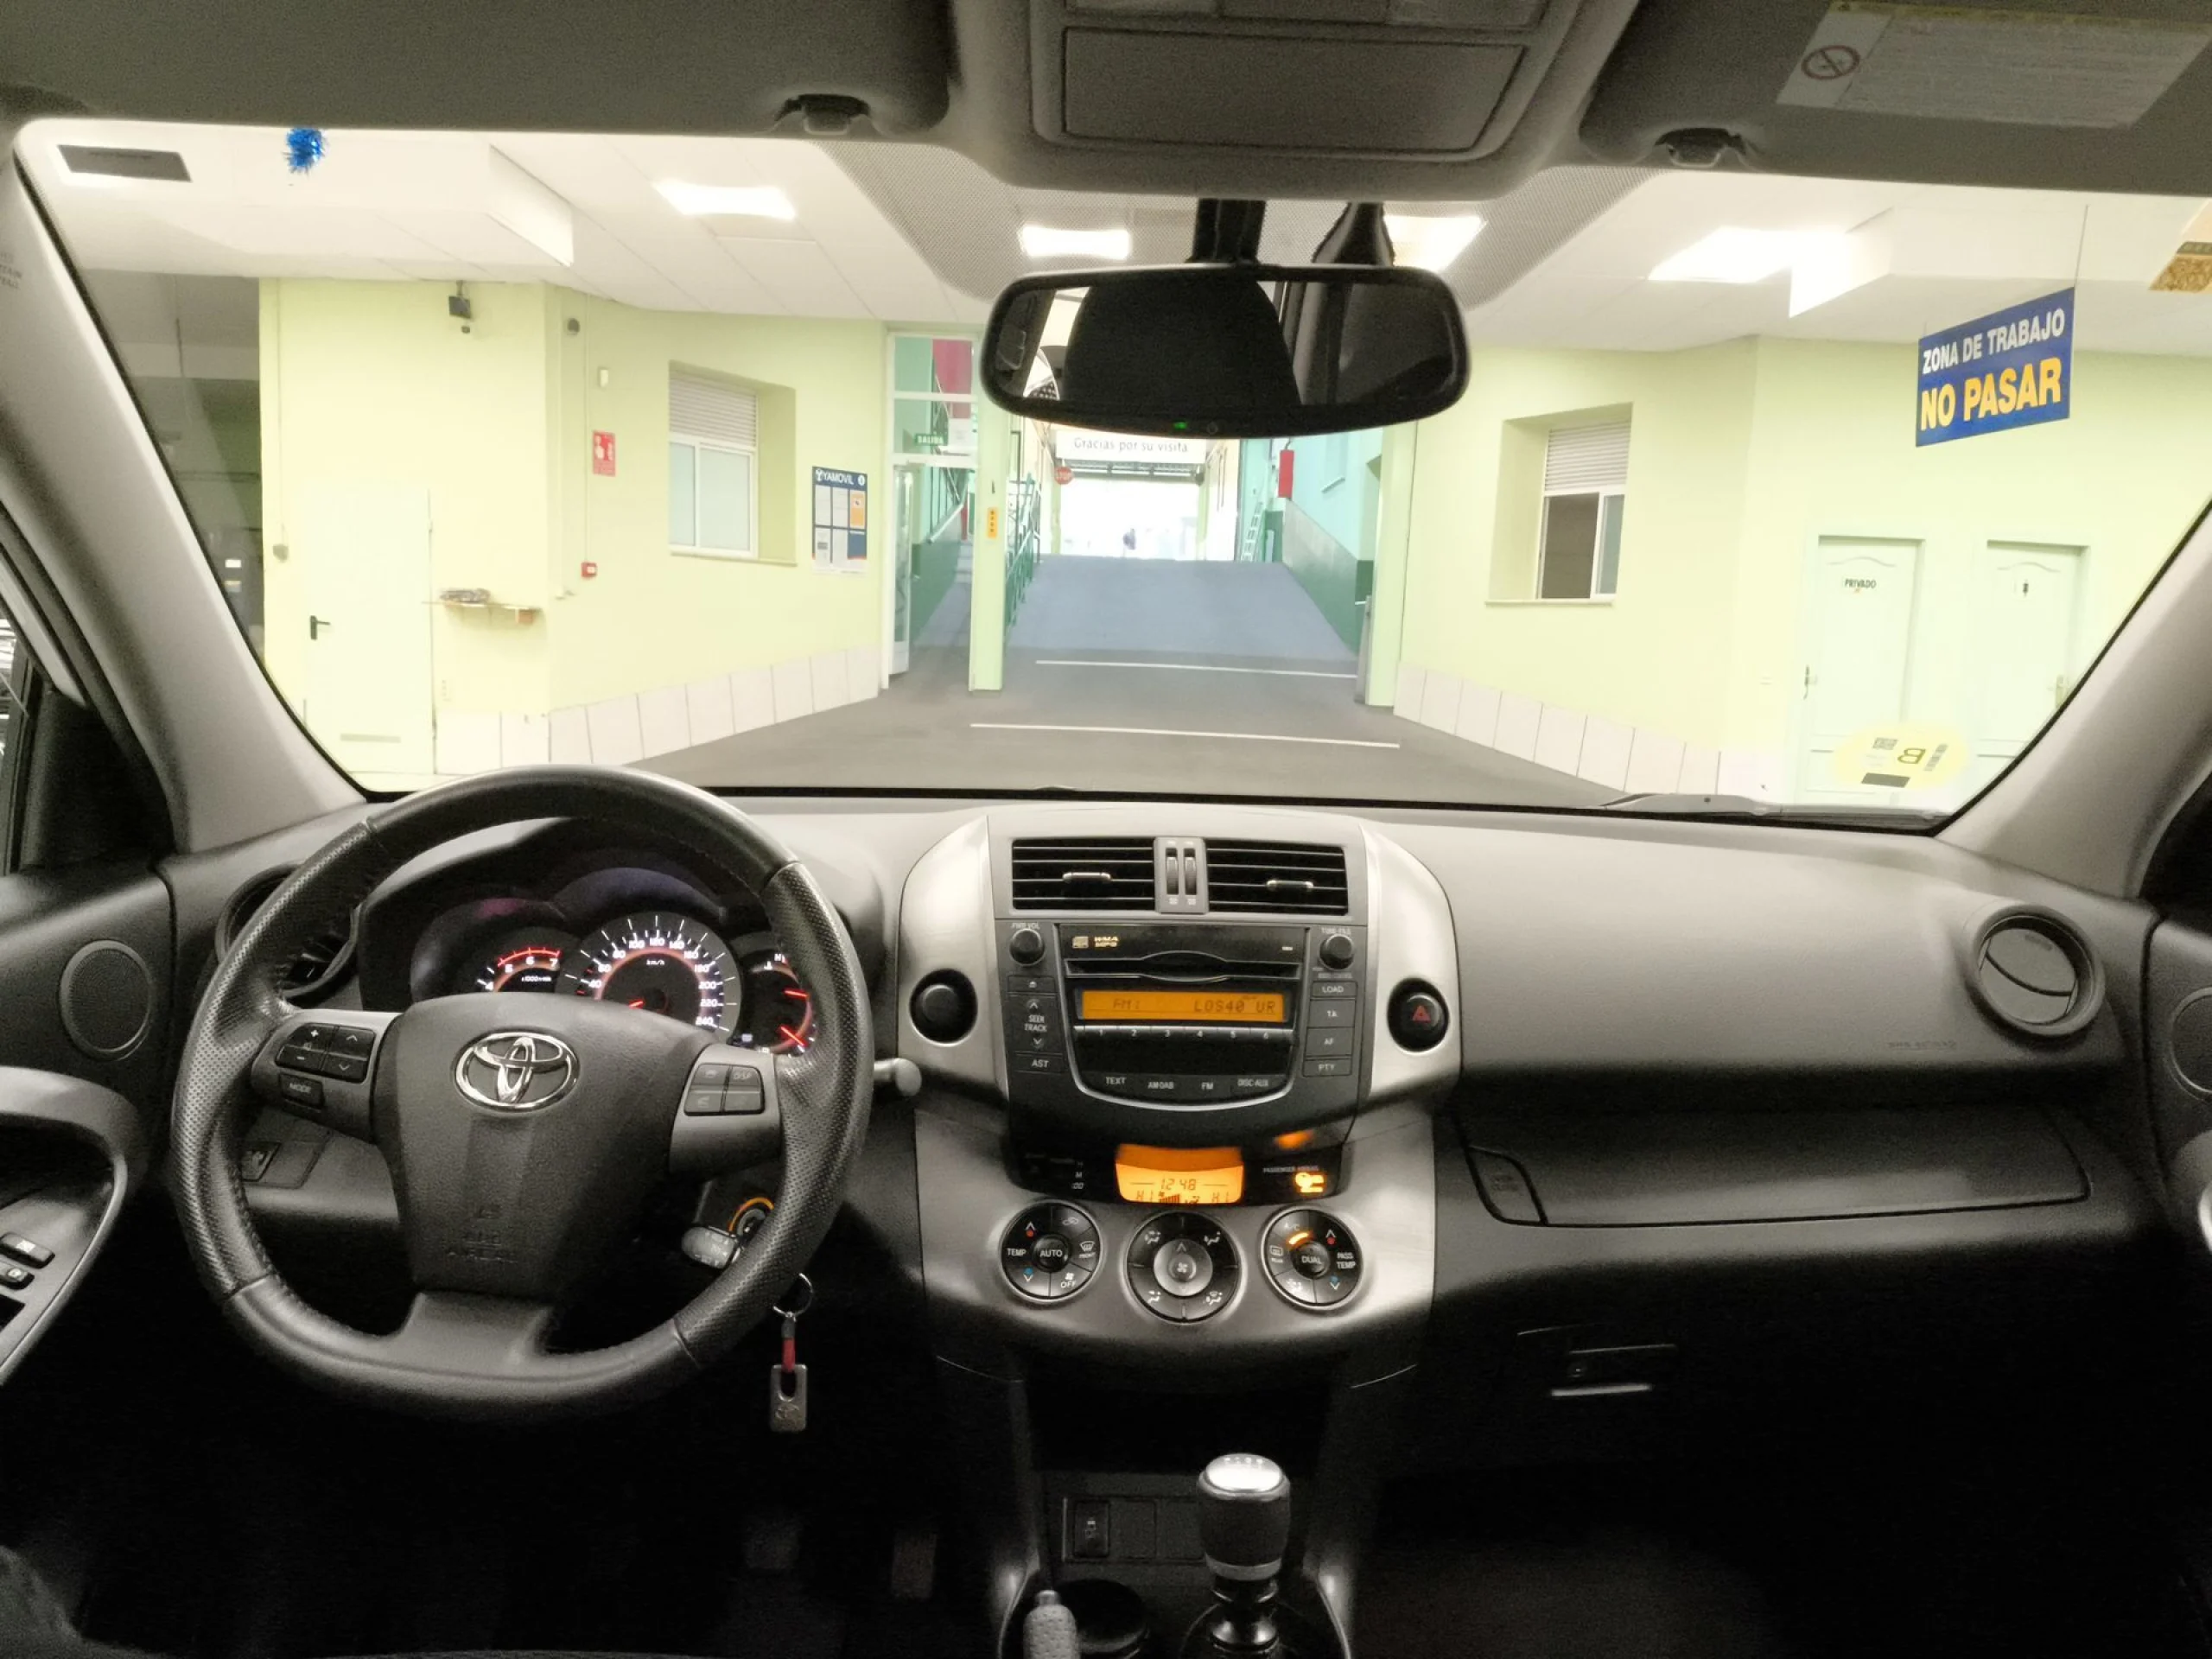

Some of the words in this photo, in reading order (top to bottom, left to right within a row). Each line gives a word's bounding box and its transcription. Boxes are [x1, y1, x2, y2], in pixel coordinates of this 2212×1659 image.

[1922, 341, 1959, 375] ZONA
[1962, 333, 1983, 363] DE
[1987, 308, 2065, 355] TRABAJO
[1921, 383, 1956, 430] NO
[1963, 356, 2062, 421] PASAR
[1073, 437, 1116, 451] Gracias
[1119, 441, 1139, 453] por
[1141, 442, 1154, 452] su
[1158, 441, 1189, 454] visita
[1844, 578, 1877, 588] PRIVADO
[629, 940, 645, 949] 100
[650, 938, 664, 946] 120
[670, 940, 685, 949] 140
[684, 950, 699, 959] 160
[525, 956, 534, 965] 6
[550, 957, 558, 967] 7
[505, 963, 513, 973] 5
[598, 963, 612, 972] 60
[695, 963, 709, 972] 180
[485, 981, 494, 990] 4
[589, 980, 602, 988] 40
[699, 981, 716, 989] 200
[700, 998, 717, 1007] 220
[696, 1016, 713, 1026] 240
[1029, 1014, 1045, 1023] SEEK
[1025, 1023, 1047, 1032] TRACK
[1230, 1030, 1236, 1039] 5
[1032, 1059, 1049, 1068] AST
[1106, 1077, 1127, 1085] TEXT
[1039, 1249, 1063, 1258] AUTO
[1301, 1255, 1322, 1264] DUAL
